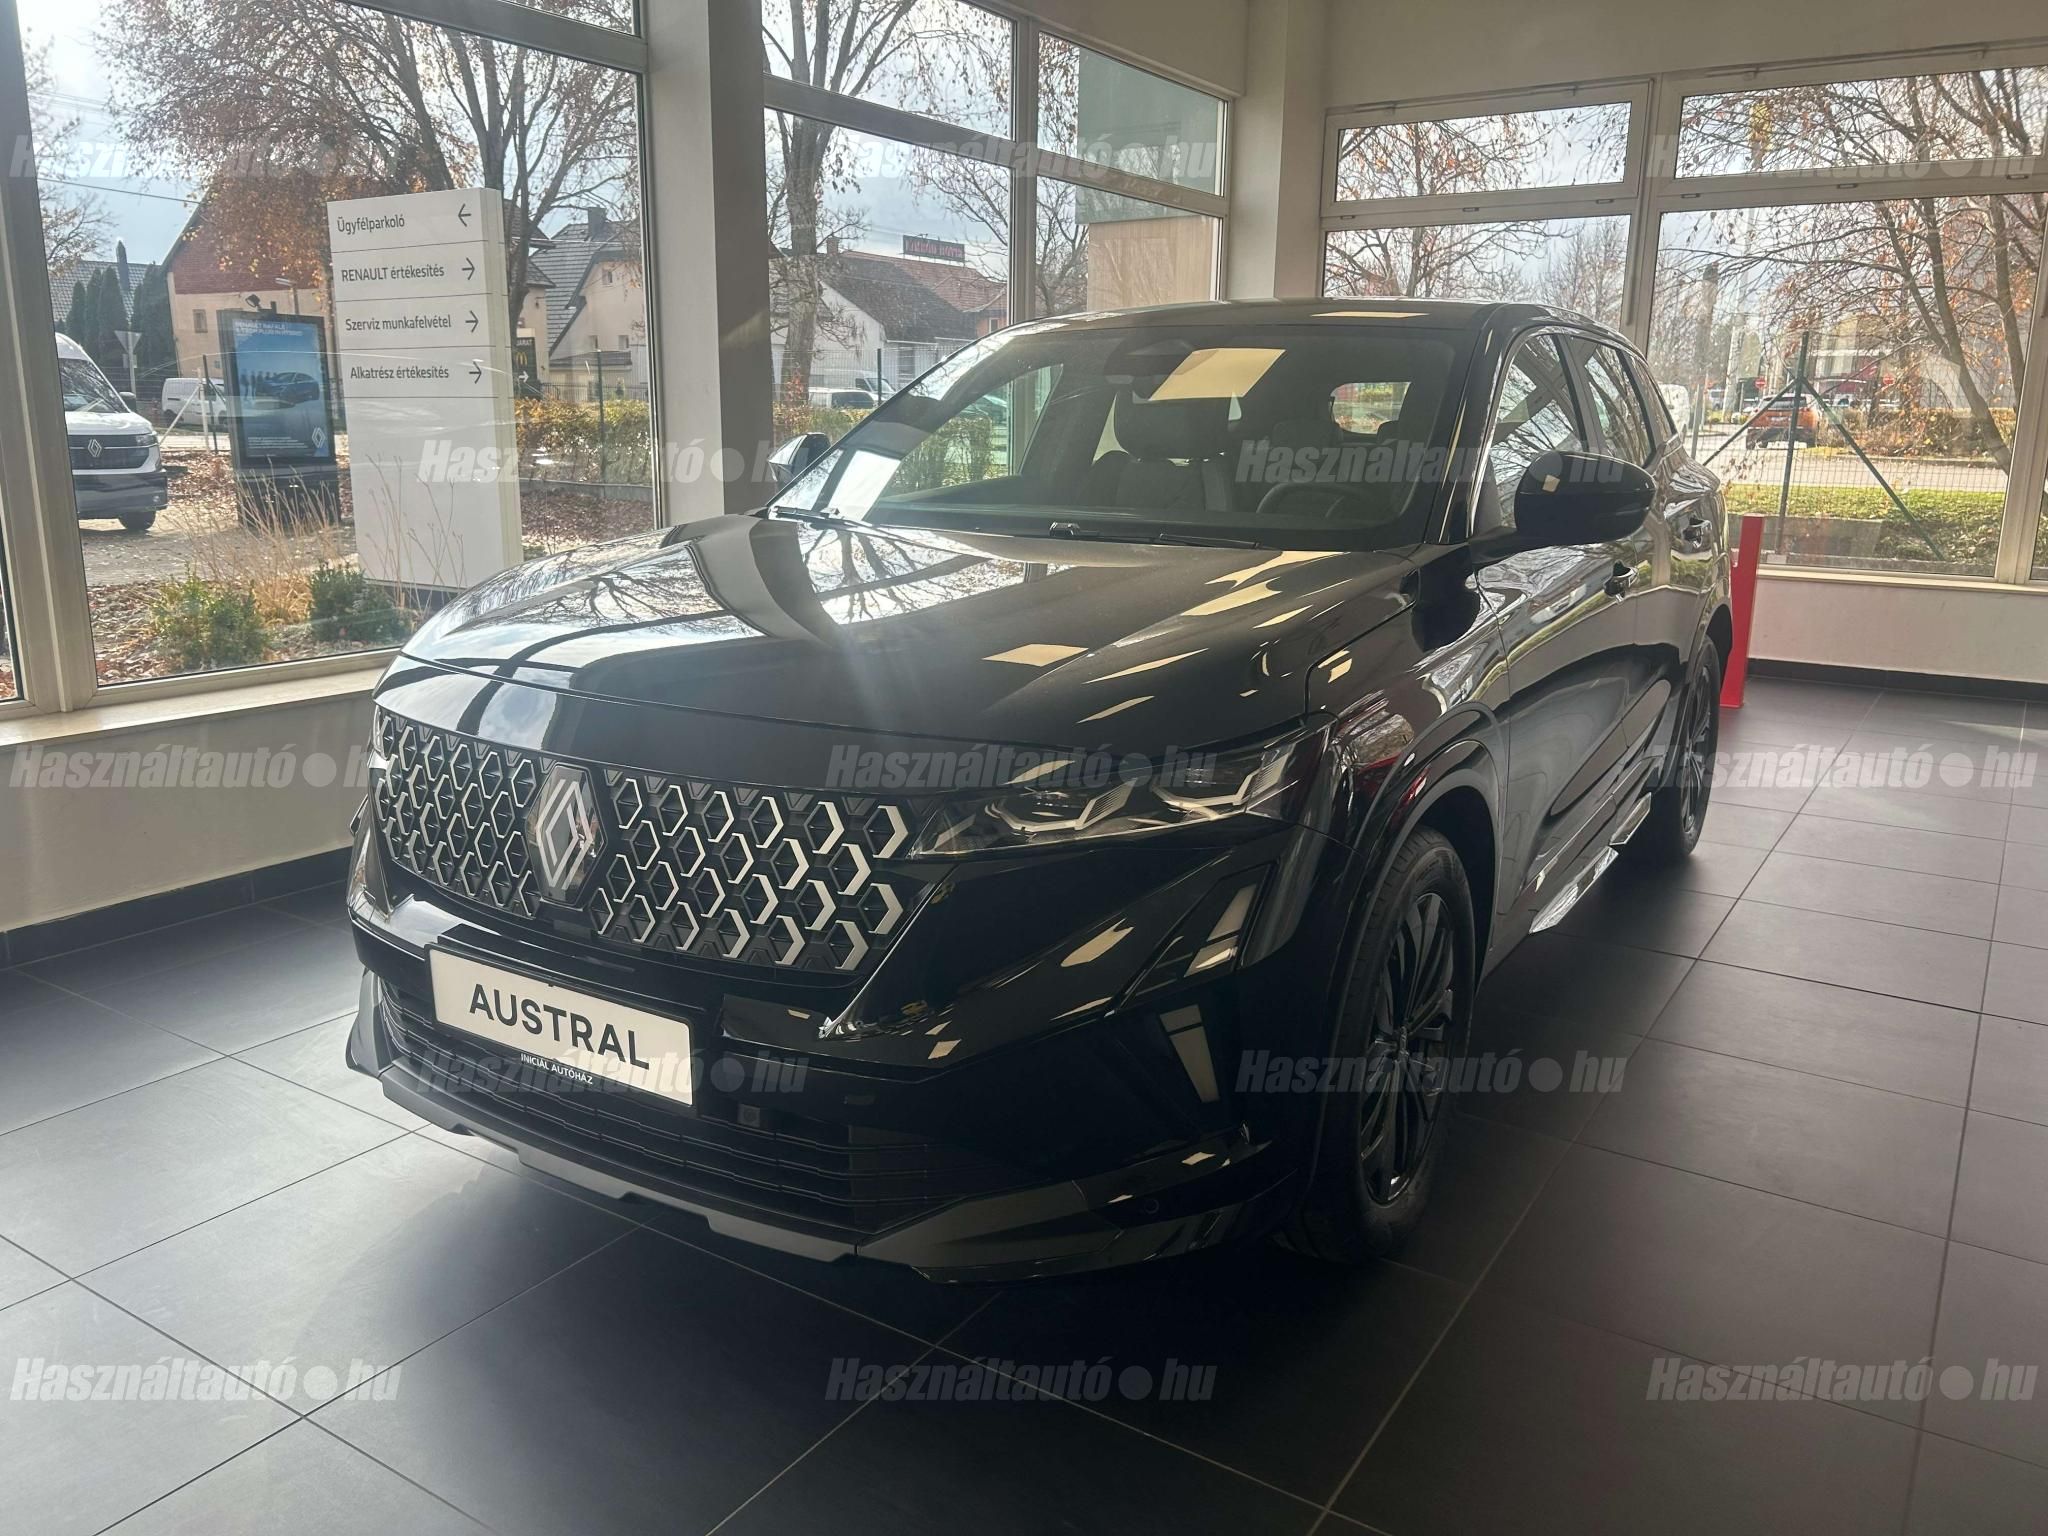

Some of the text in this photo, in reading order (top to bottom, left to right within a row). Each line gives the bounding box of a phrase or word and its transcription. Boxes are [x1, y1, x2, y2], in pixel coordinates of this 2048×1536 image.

[337, 214, 405, 235] Ügyfélparkoló
[341, 264, 445, 281] RENAULT értékesítés
[345, 315, 451, 331] Szerviz munkafelvétel
[350, 366, 449, 379] Alkatrész értékesítés
[469, 983, 650, 1070] AUSTRAL
[551, 1064, 593, 1085] AUTÓHÁZ
